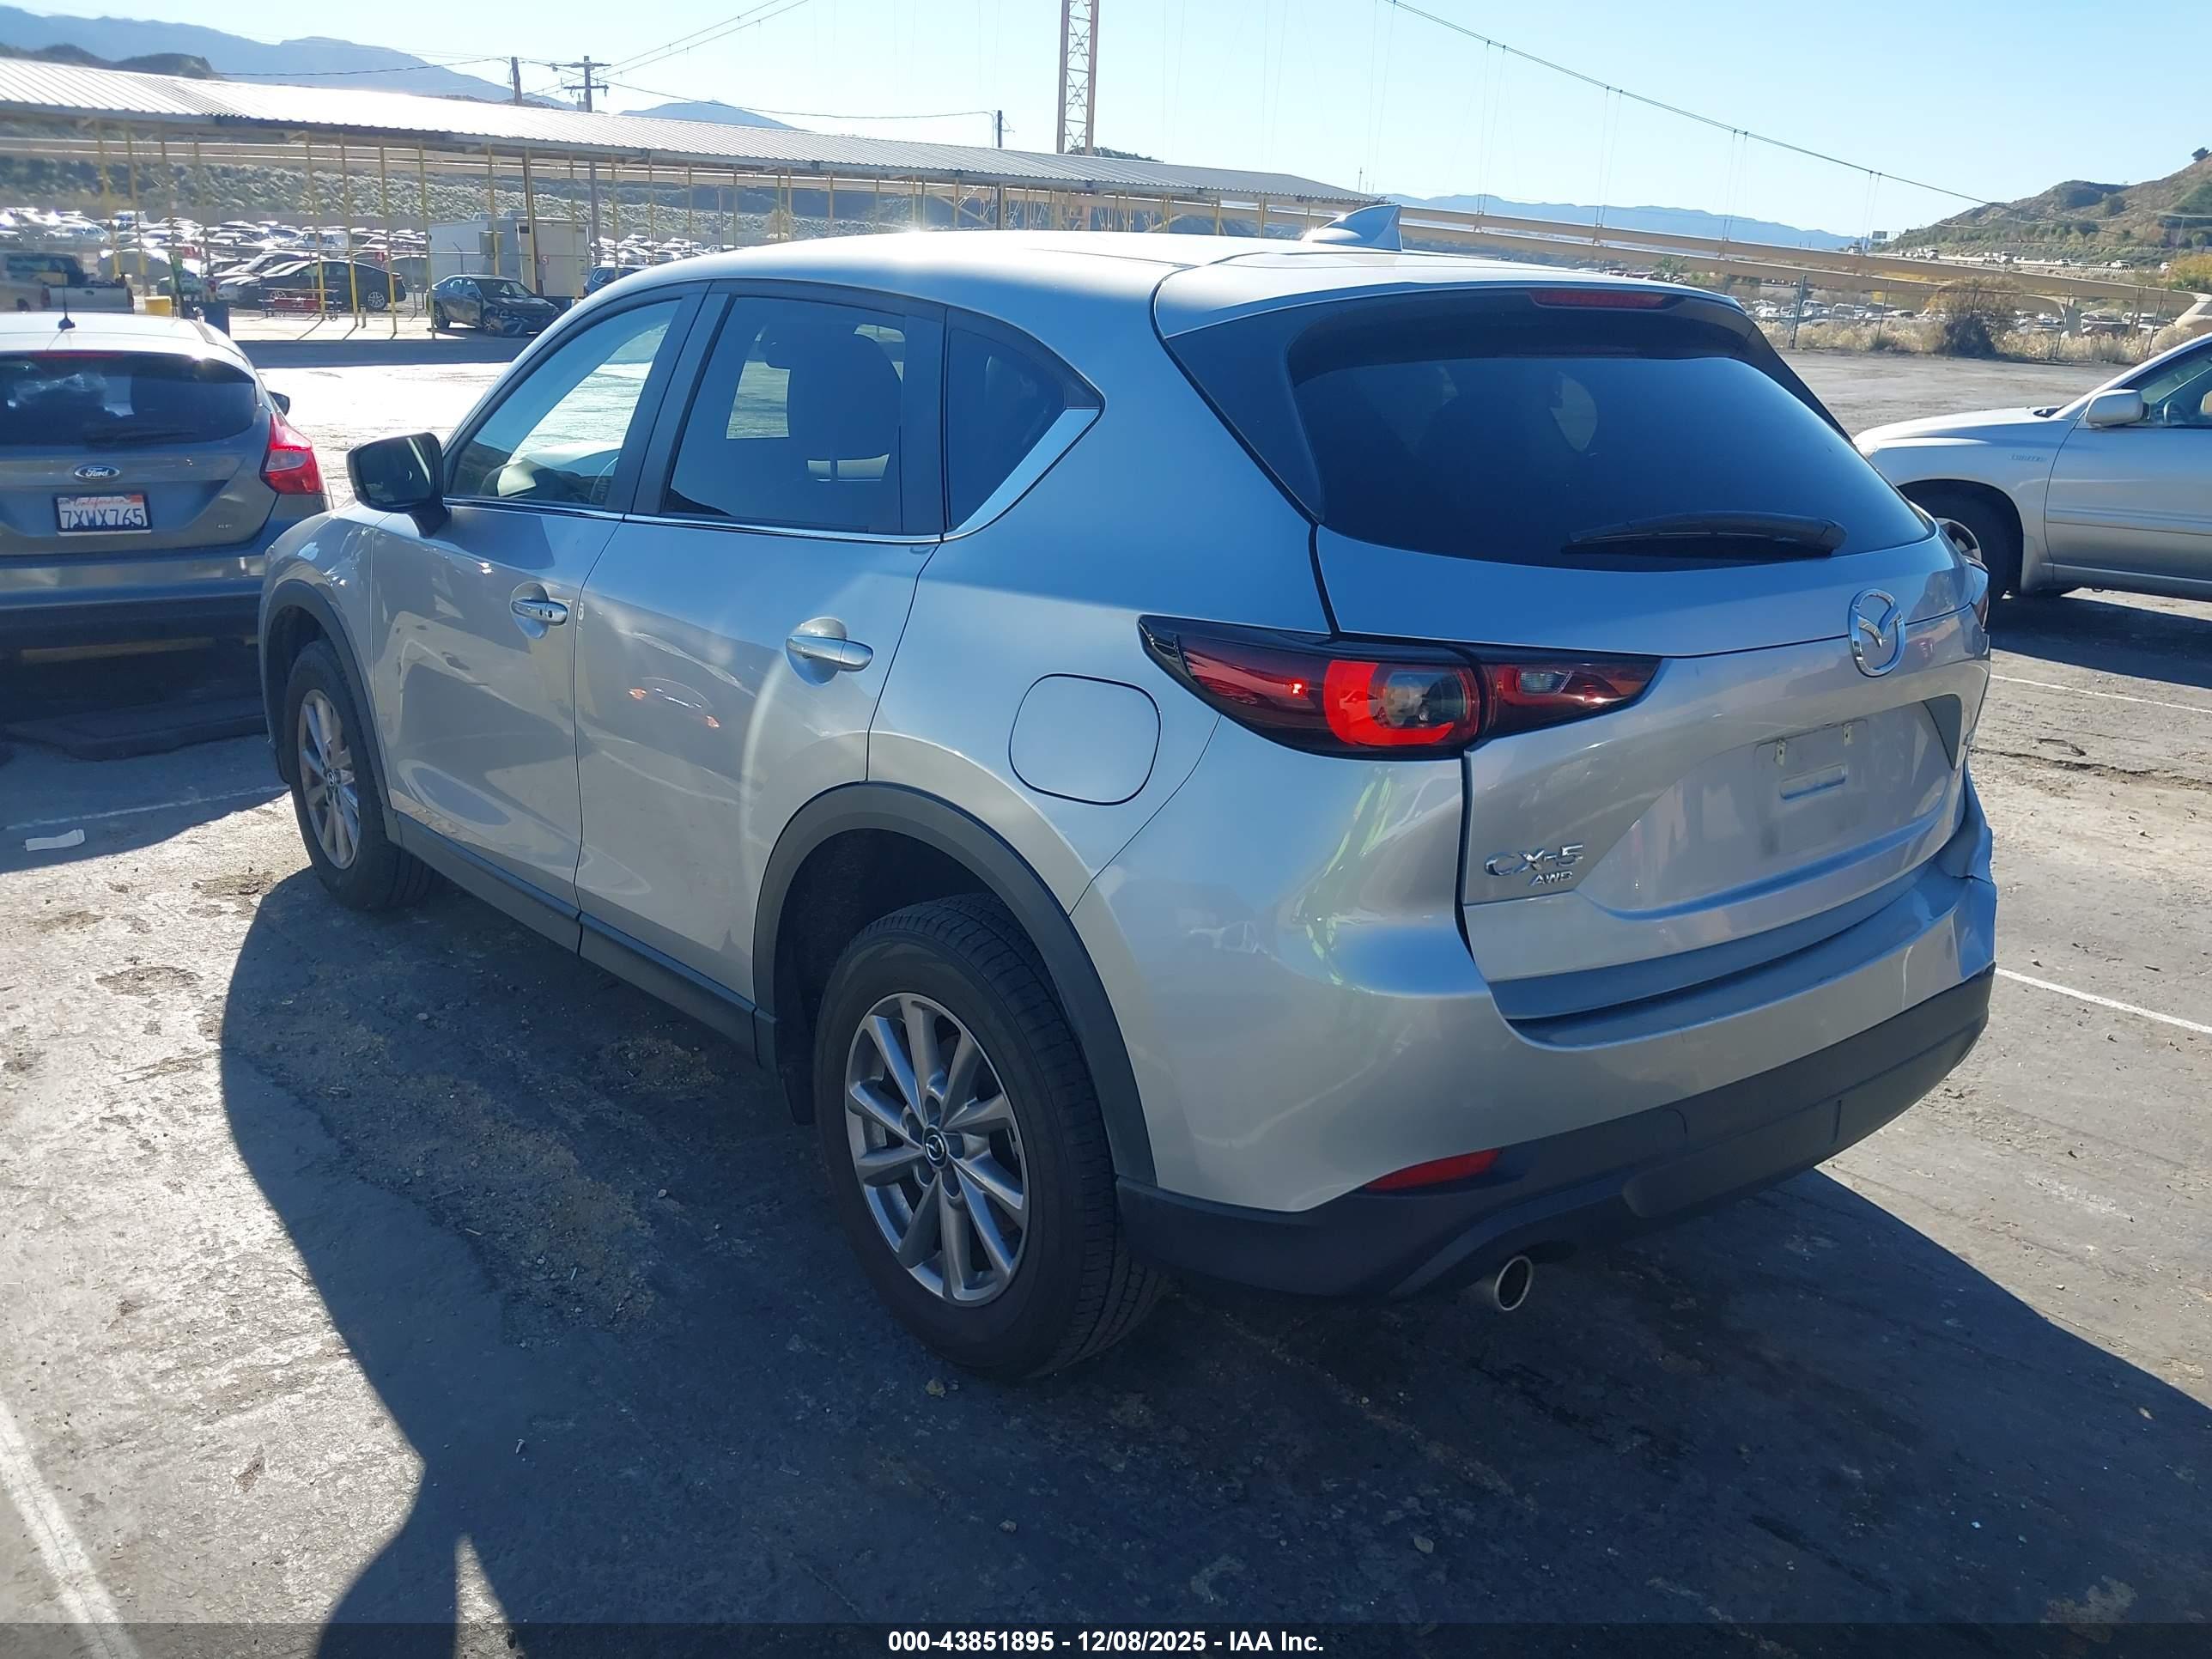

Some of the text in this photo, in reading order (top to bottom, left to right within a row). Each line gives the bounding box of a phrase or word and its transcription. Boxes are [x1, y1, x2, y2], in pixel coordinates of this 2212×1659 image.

[74, 495, 125, 508] California
[62, 507, 144, 529] 7XWX765
[1484, 843, 1583, 876] CX-5
[1528, 871, 1573, 886] AWD
